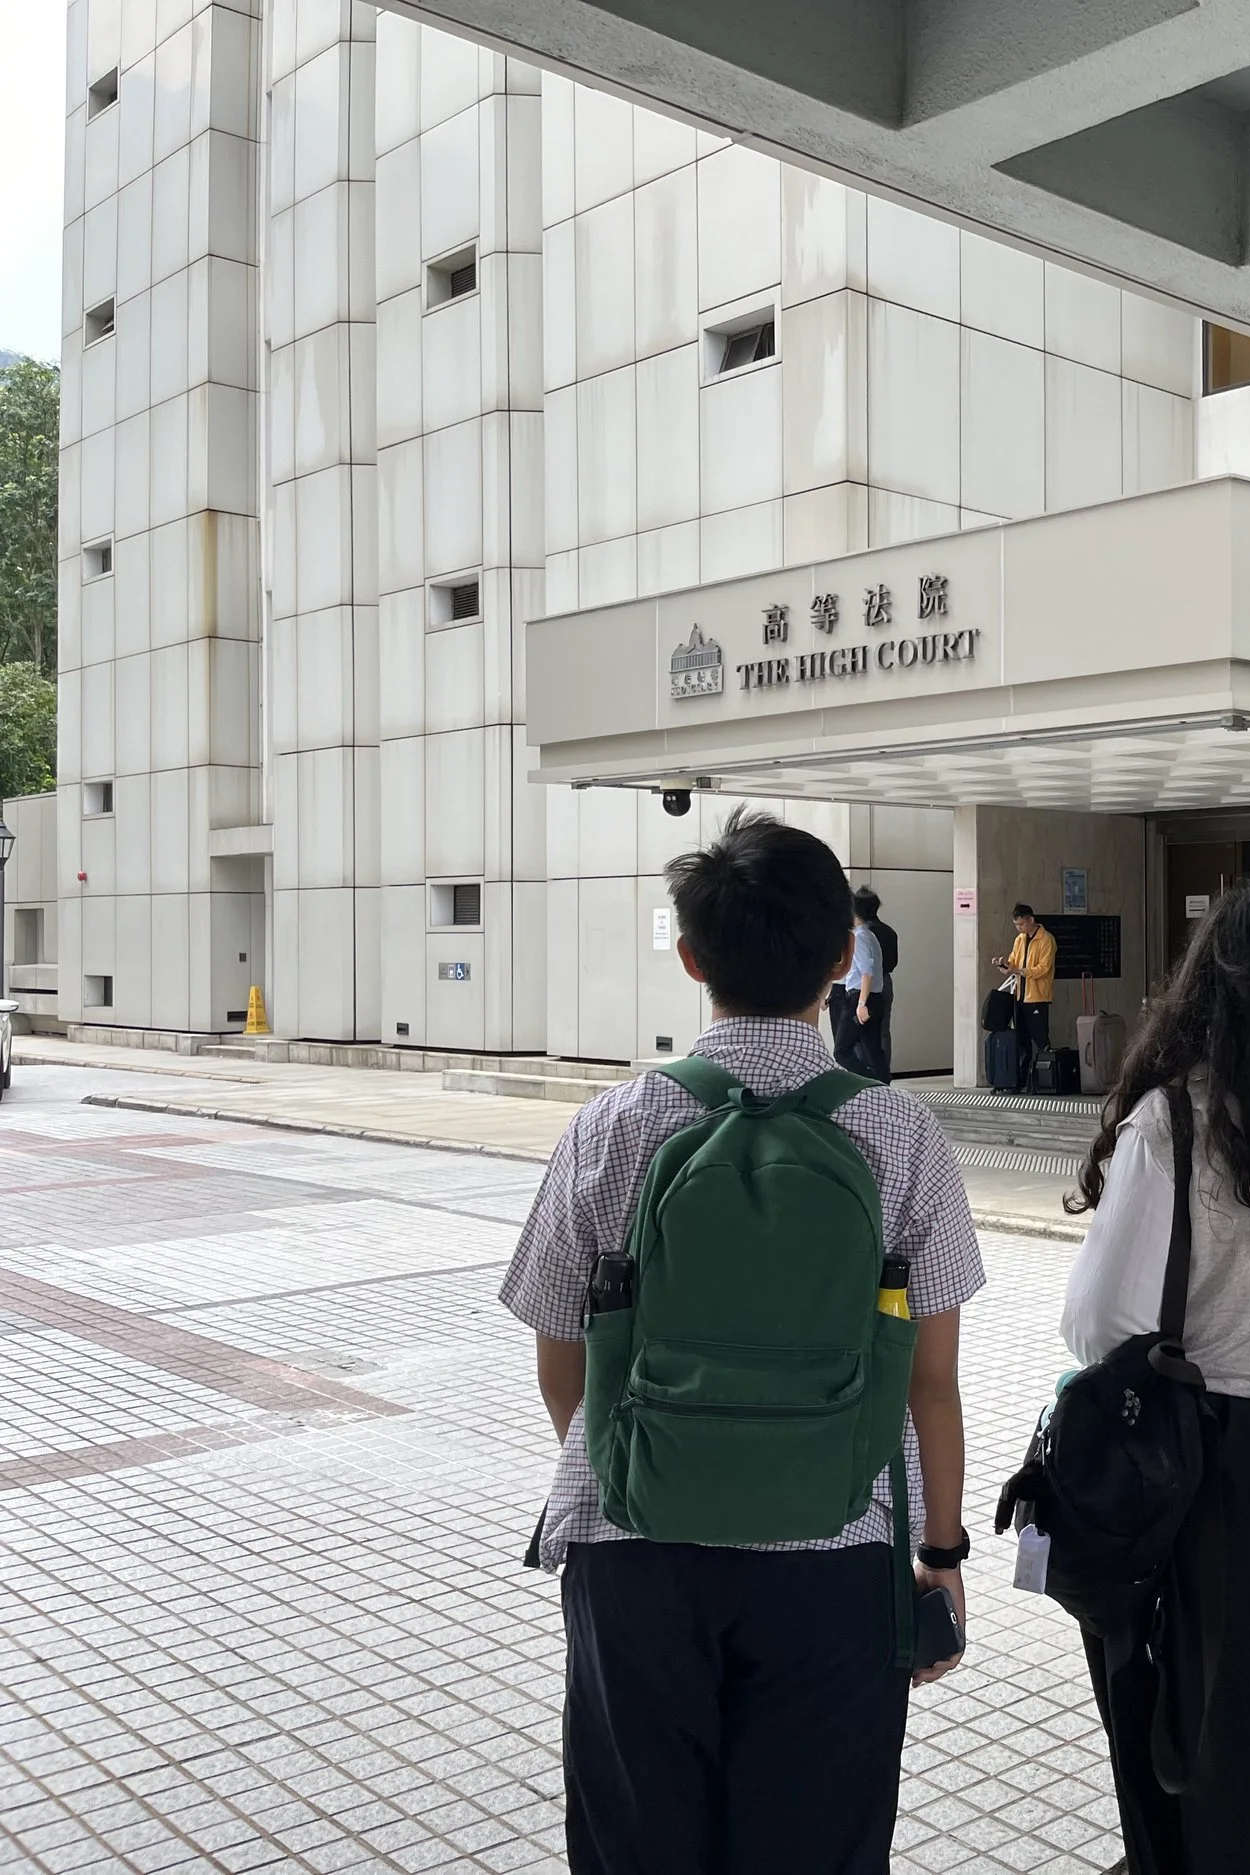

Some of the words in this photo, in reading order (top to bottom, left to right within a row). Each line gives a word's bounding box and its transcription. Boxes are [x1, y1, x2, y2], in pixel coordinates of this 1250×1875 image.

[761, 574, 949, 645] 高等法院
[736, 657, 790, 690] THE
[793, 645, 869, 682] HIGH
[874, 628, 981, 671] COURT
